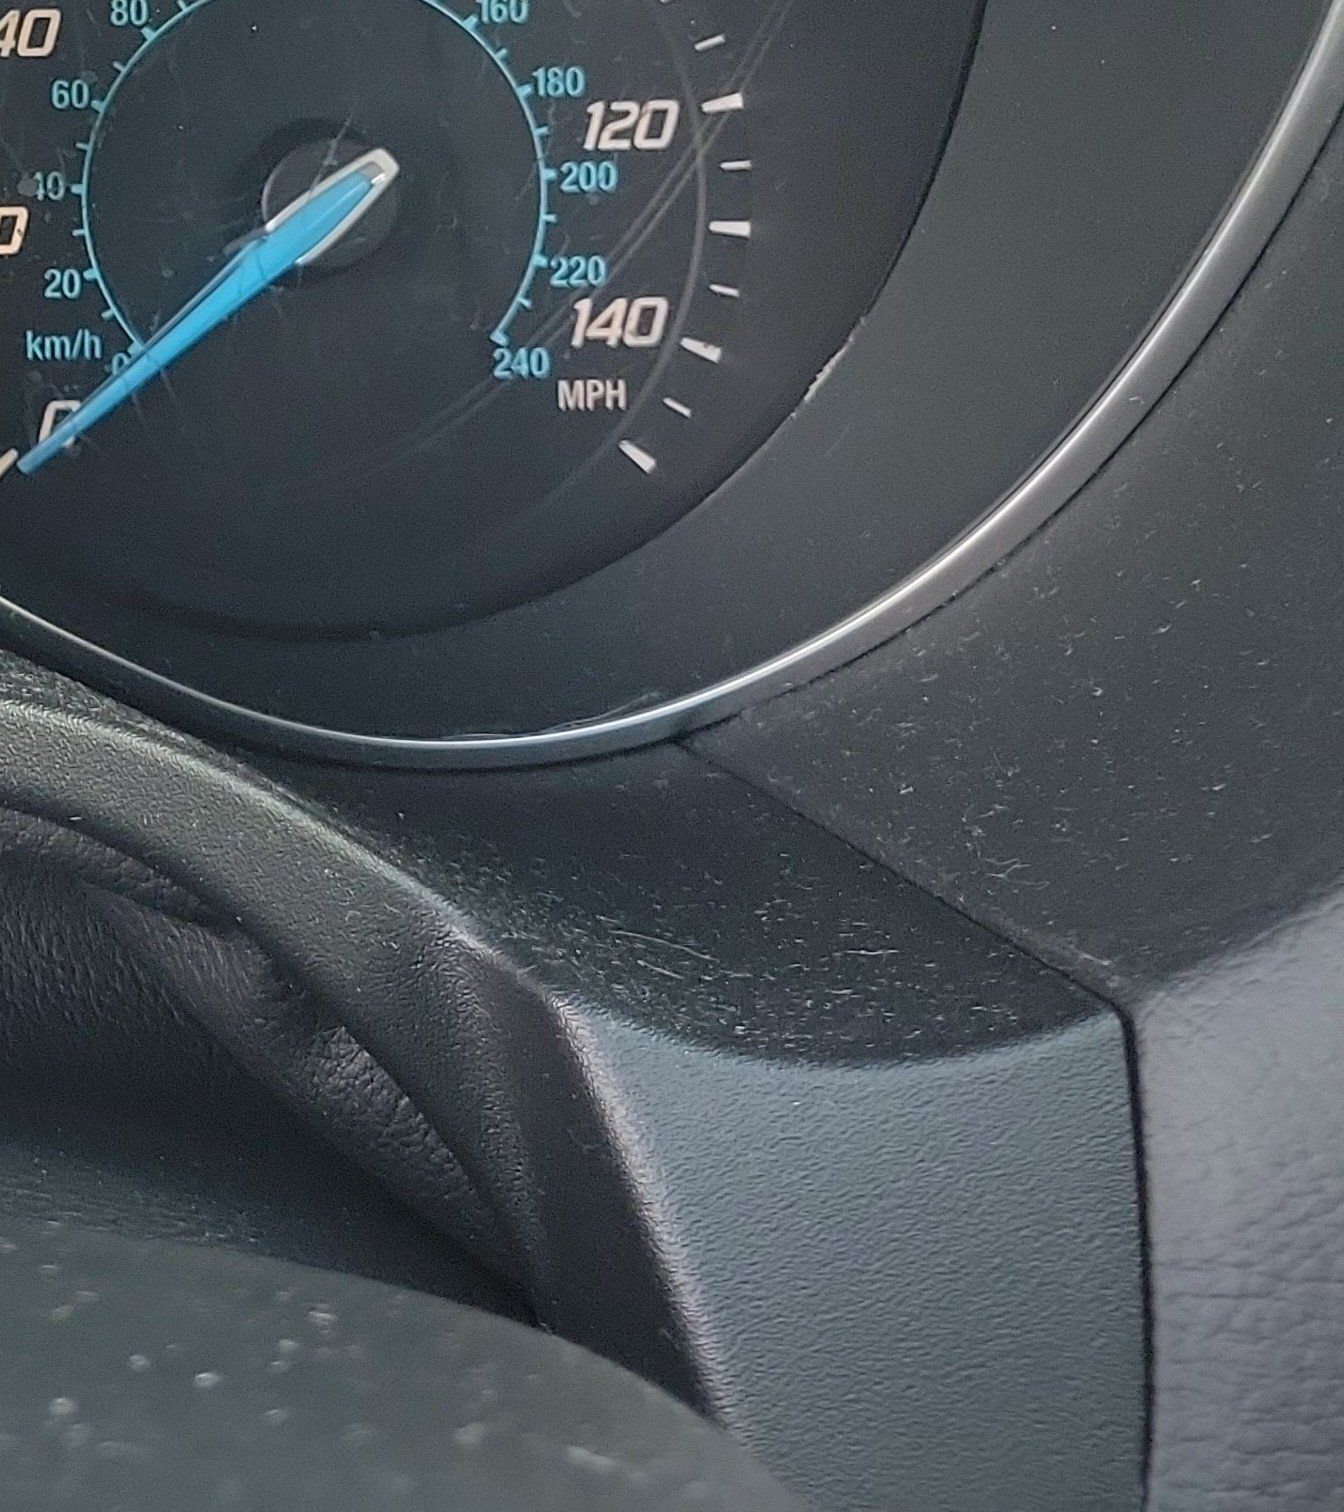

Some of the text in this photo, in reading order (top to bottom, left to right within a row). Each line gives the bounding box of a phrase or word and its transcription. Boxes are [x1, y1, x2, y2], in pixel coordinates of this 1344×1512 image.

[52, 79, 88, 108] 60
[533, 67, 584, 96] 180
[584, 100, 679, 150] 120
[561, 161, 617, 191] 200
[45, 269, 80, 298] 20
[551, 256, 606, 286] 220
[572, 297, 668, 347] 140
[27, 329, 100, 359] km/h
[494, 348, 550, 379] 240
[558, 380, 625, 410] MPH
